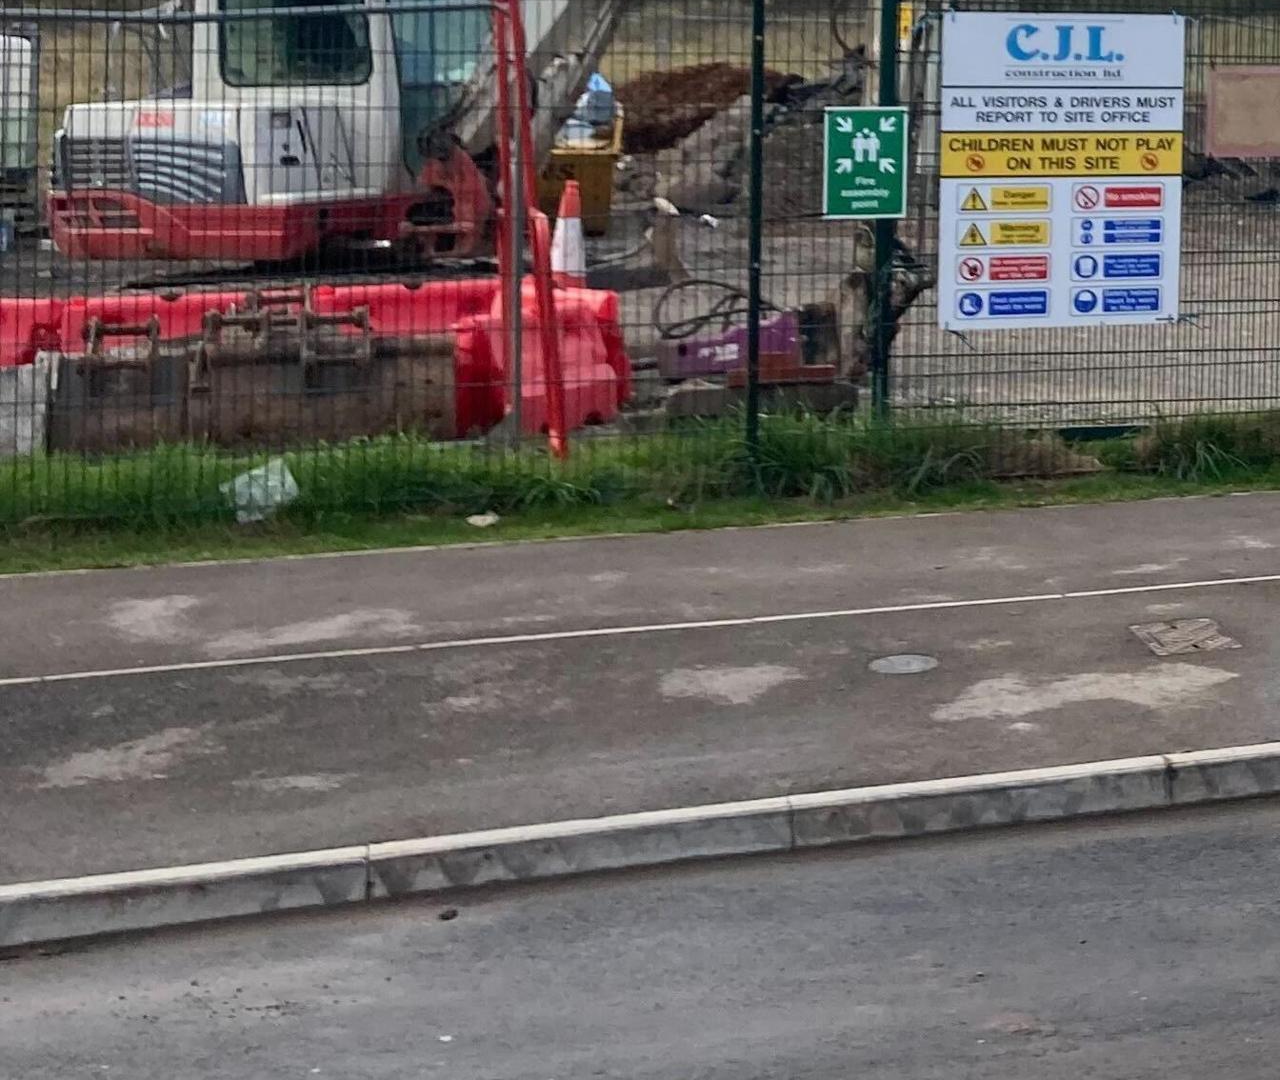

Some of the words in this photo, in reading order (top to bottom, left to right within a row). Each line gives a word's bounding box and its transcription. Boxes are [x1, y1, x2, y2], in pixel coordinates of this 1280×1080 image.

[1005, 24, 1124, 62] C.J.L.
[1004, 68, 1096, 78] construction
[950, 96, 976, 108] ALL
[982, 96, 1048, 108] VISITORS
[1054, 97, 1063, 108] &
[1070, 96, 1131, 107] DRIVERS
[1137, 97, 1176, 108] MUST
[975, 111, 1034, 123] REPORT
[1040, 111, 1058, 122] TO
[1065, 111, 1095, 122] SITE
[1101, 112, 1150, 122] OFFICE
[948, 139, 1035, 152] CHILDREN
[1041, 139, 1088, 152] MUST
[1096, 139, 1129, 152] NOT
[1136, 139, 1176, 152] PLAY
[1007, 157, 1034, 170] ON
[1040, 157, 1078, 170] THIS
[1084, 157, 1120, 170] SITE
[854, 177, 876, 186] Fire
[841, 188, 890, 198] assembly
[851, 199, 879, 209] point
